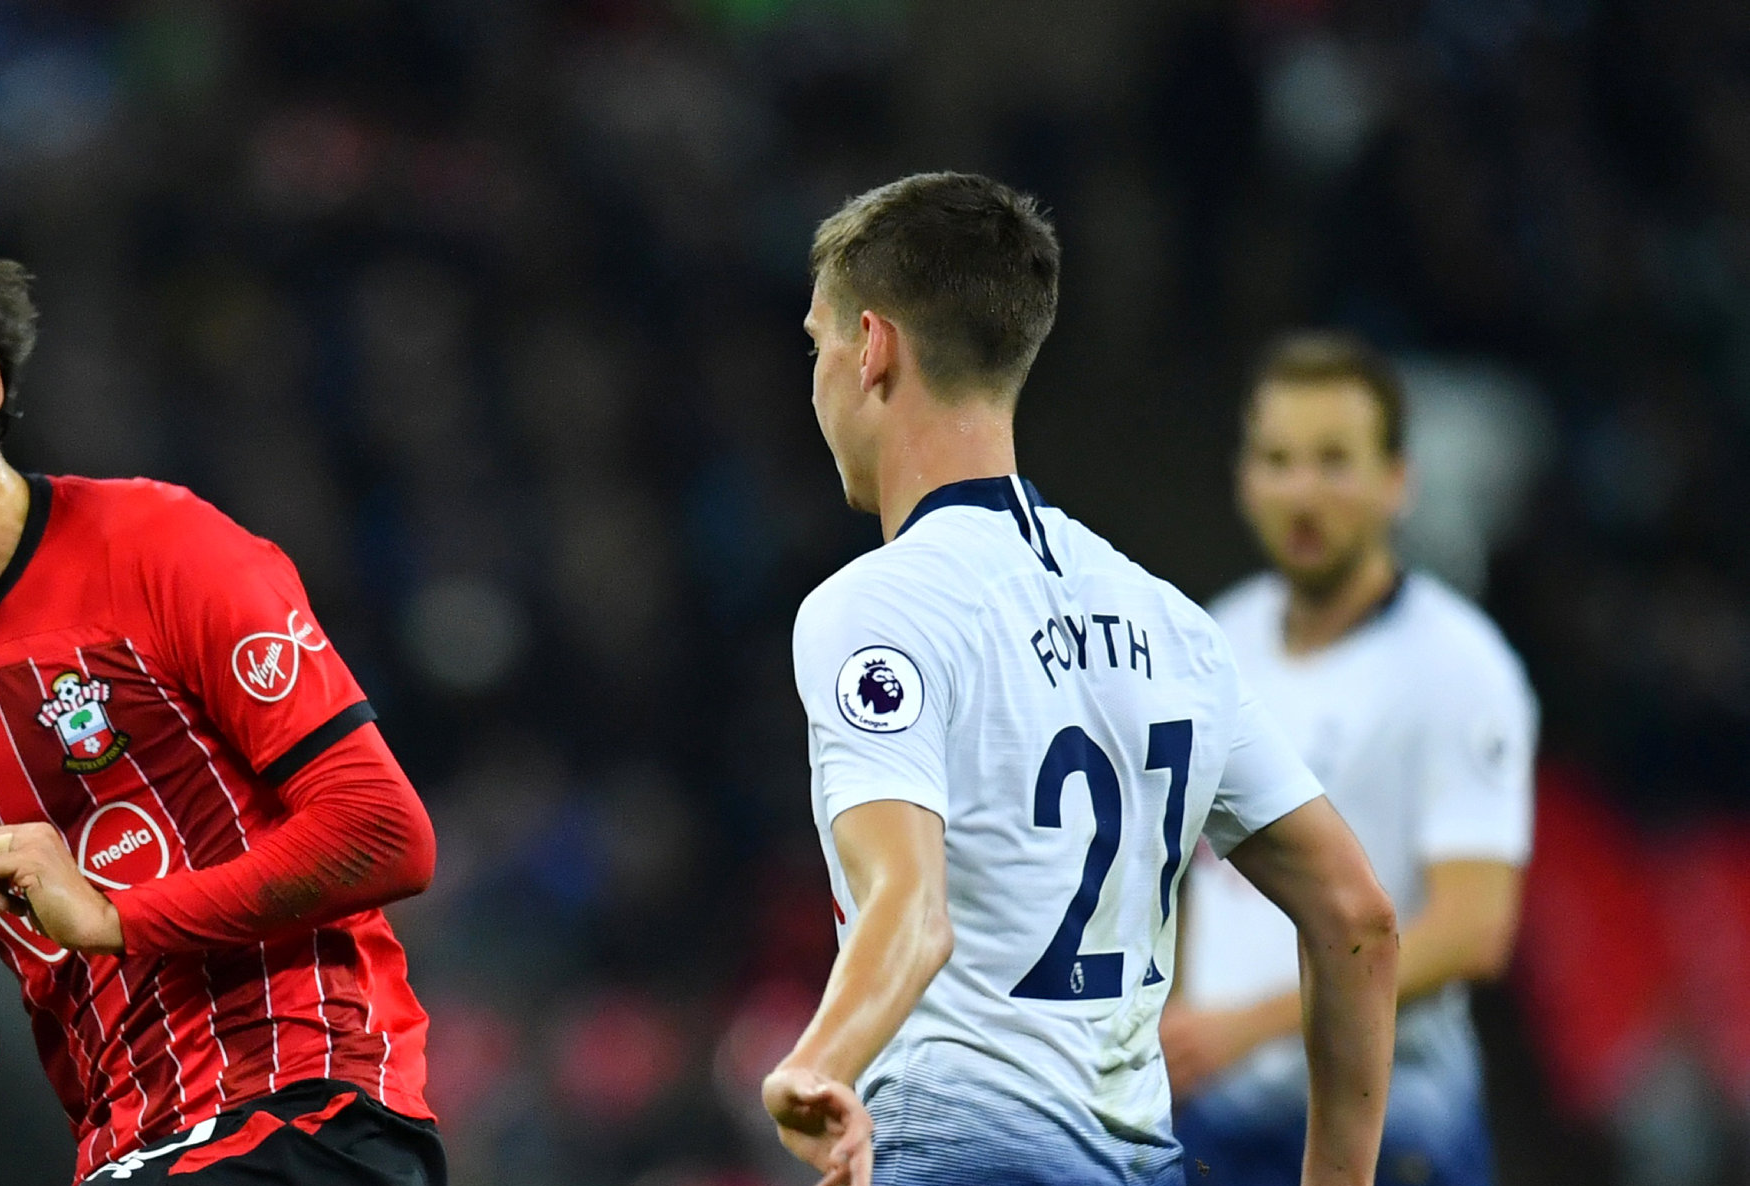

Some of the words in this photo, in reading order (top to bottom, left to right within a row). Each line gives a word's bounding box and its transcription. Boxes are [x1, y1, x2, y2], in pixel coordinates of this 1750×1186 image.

[247, 641, 286, 689] Virgin
[1030, 614, 1152, 689] FOYTH
[90, 828, 153, 870] media
[1008, 718, 1193, 1001] 21
